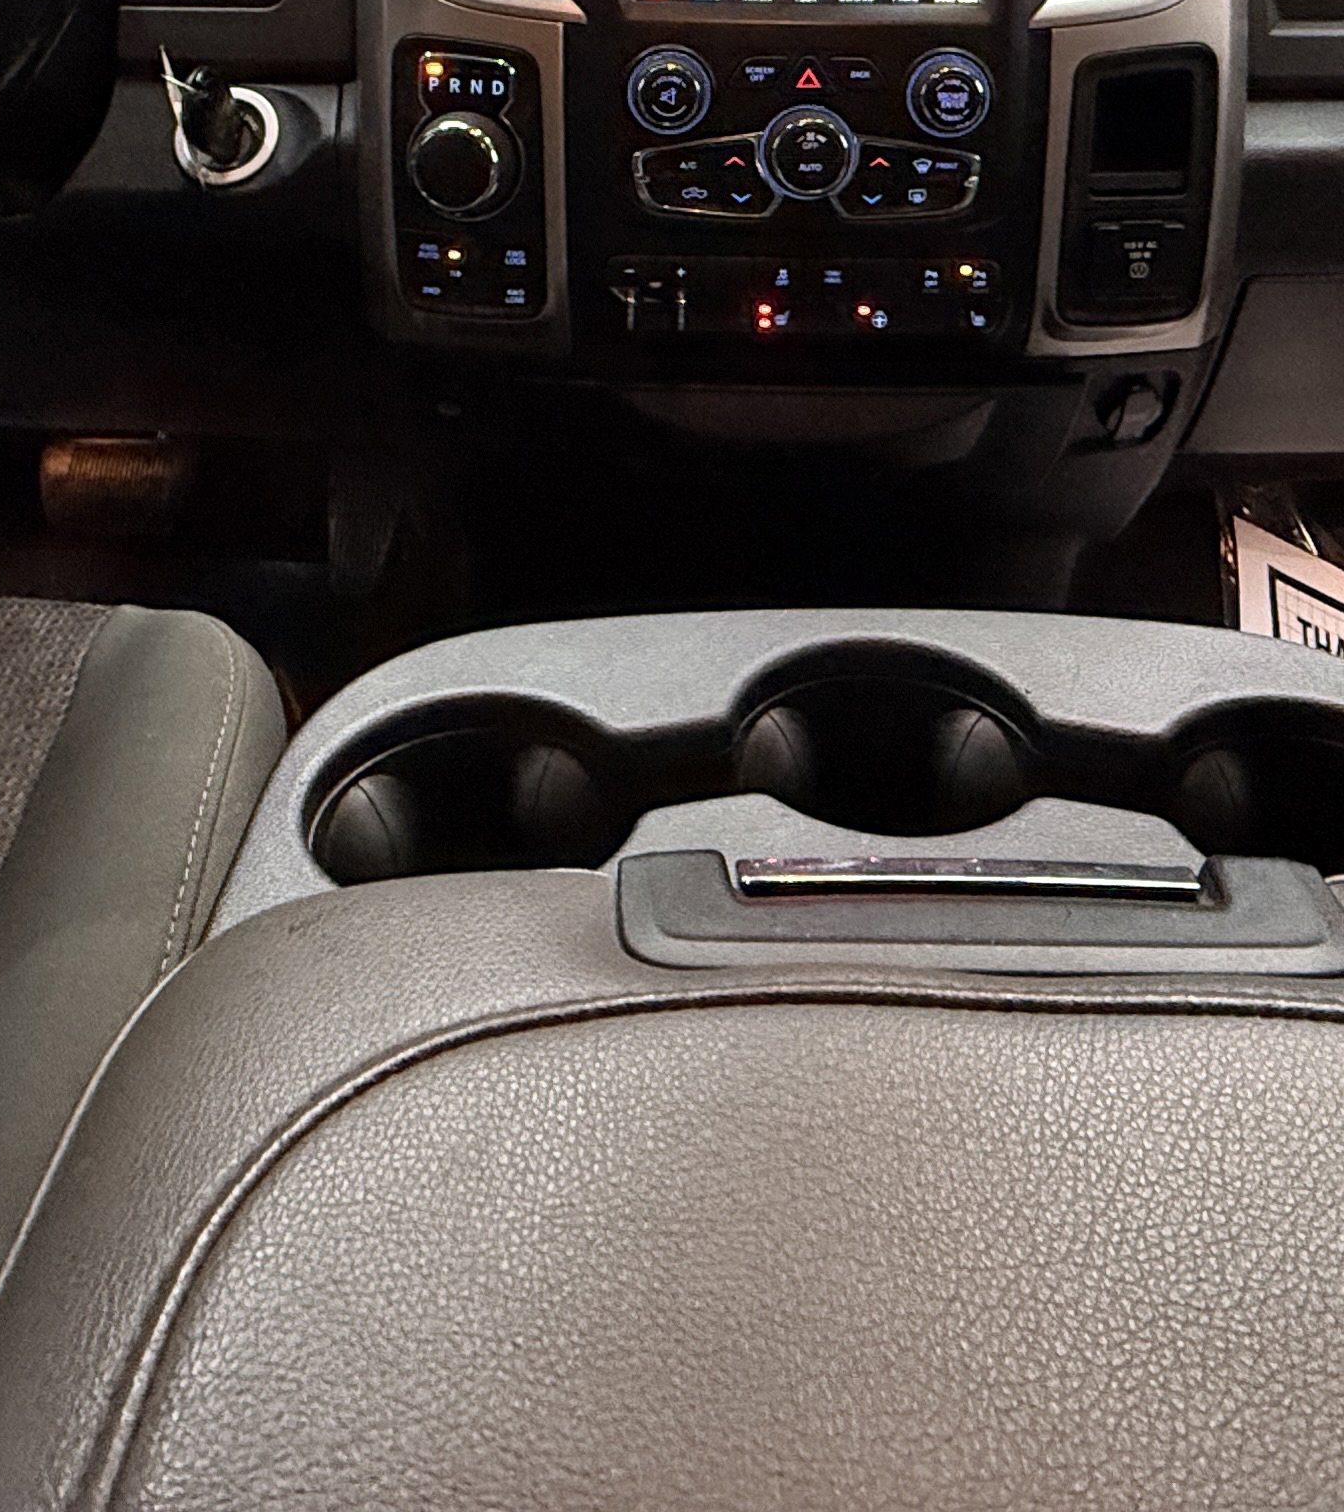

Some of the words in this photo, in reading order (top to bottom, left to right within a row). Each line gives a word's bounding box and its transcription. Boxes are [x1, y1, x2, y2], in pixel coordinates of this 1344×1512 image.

[428, 76, 440, 93] P
[449, 78, 461, 93] R
[470, 79, 483, 95] N
[491, 80, 505, 95] D
[798, 163, 822, 172] AUTO
